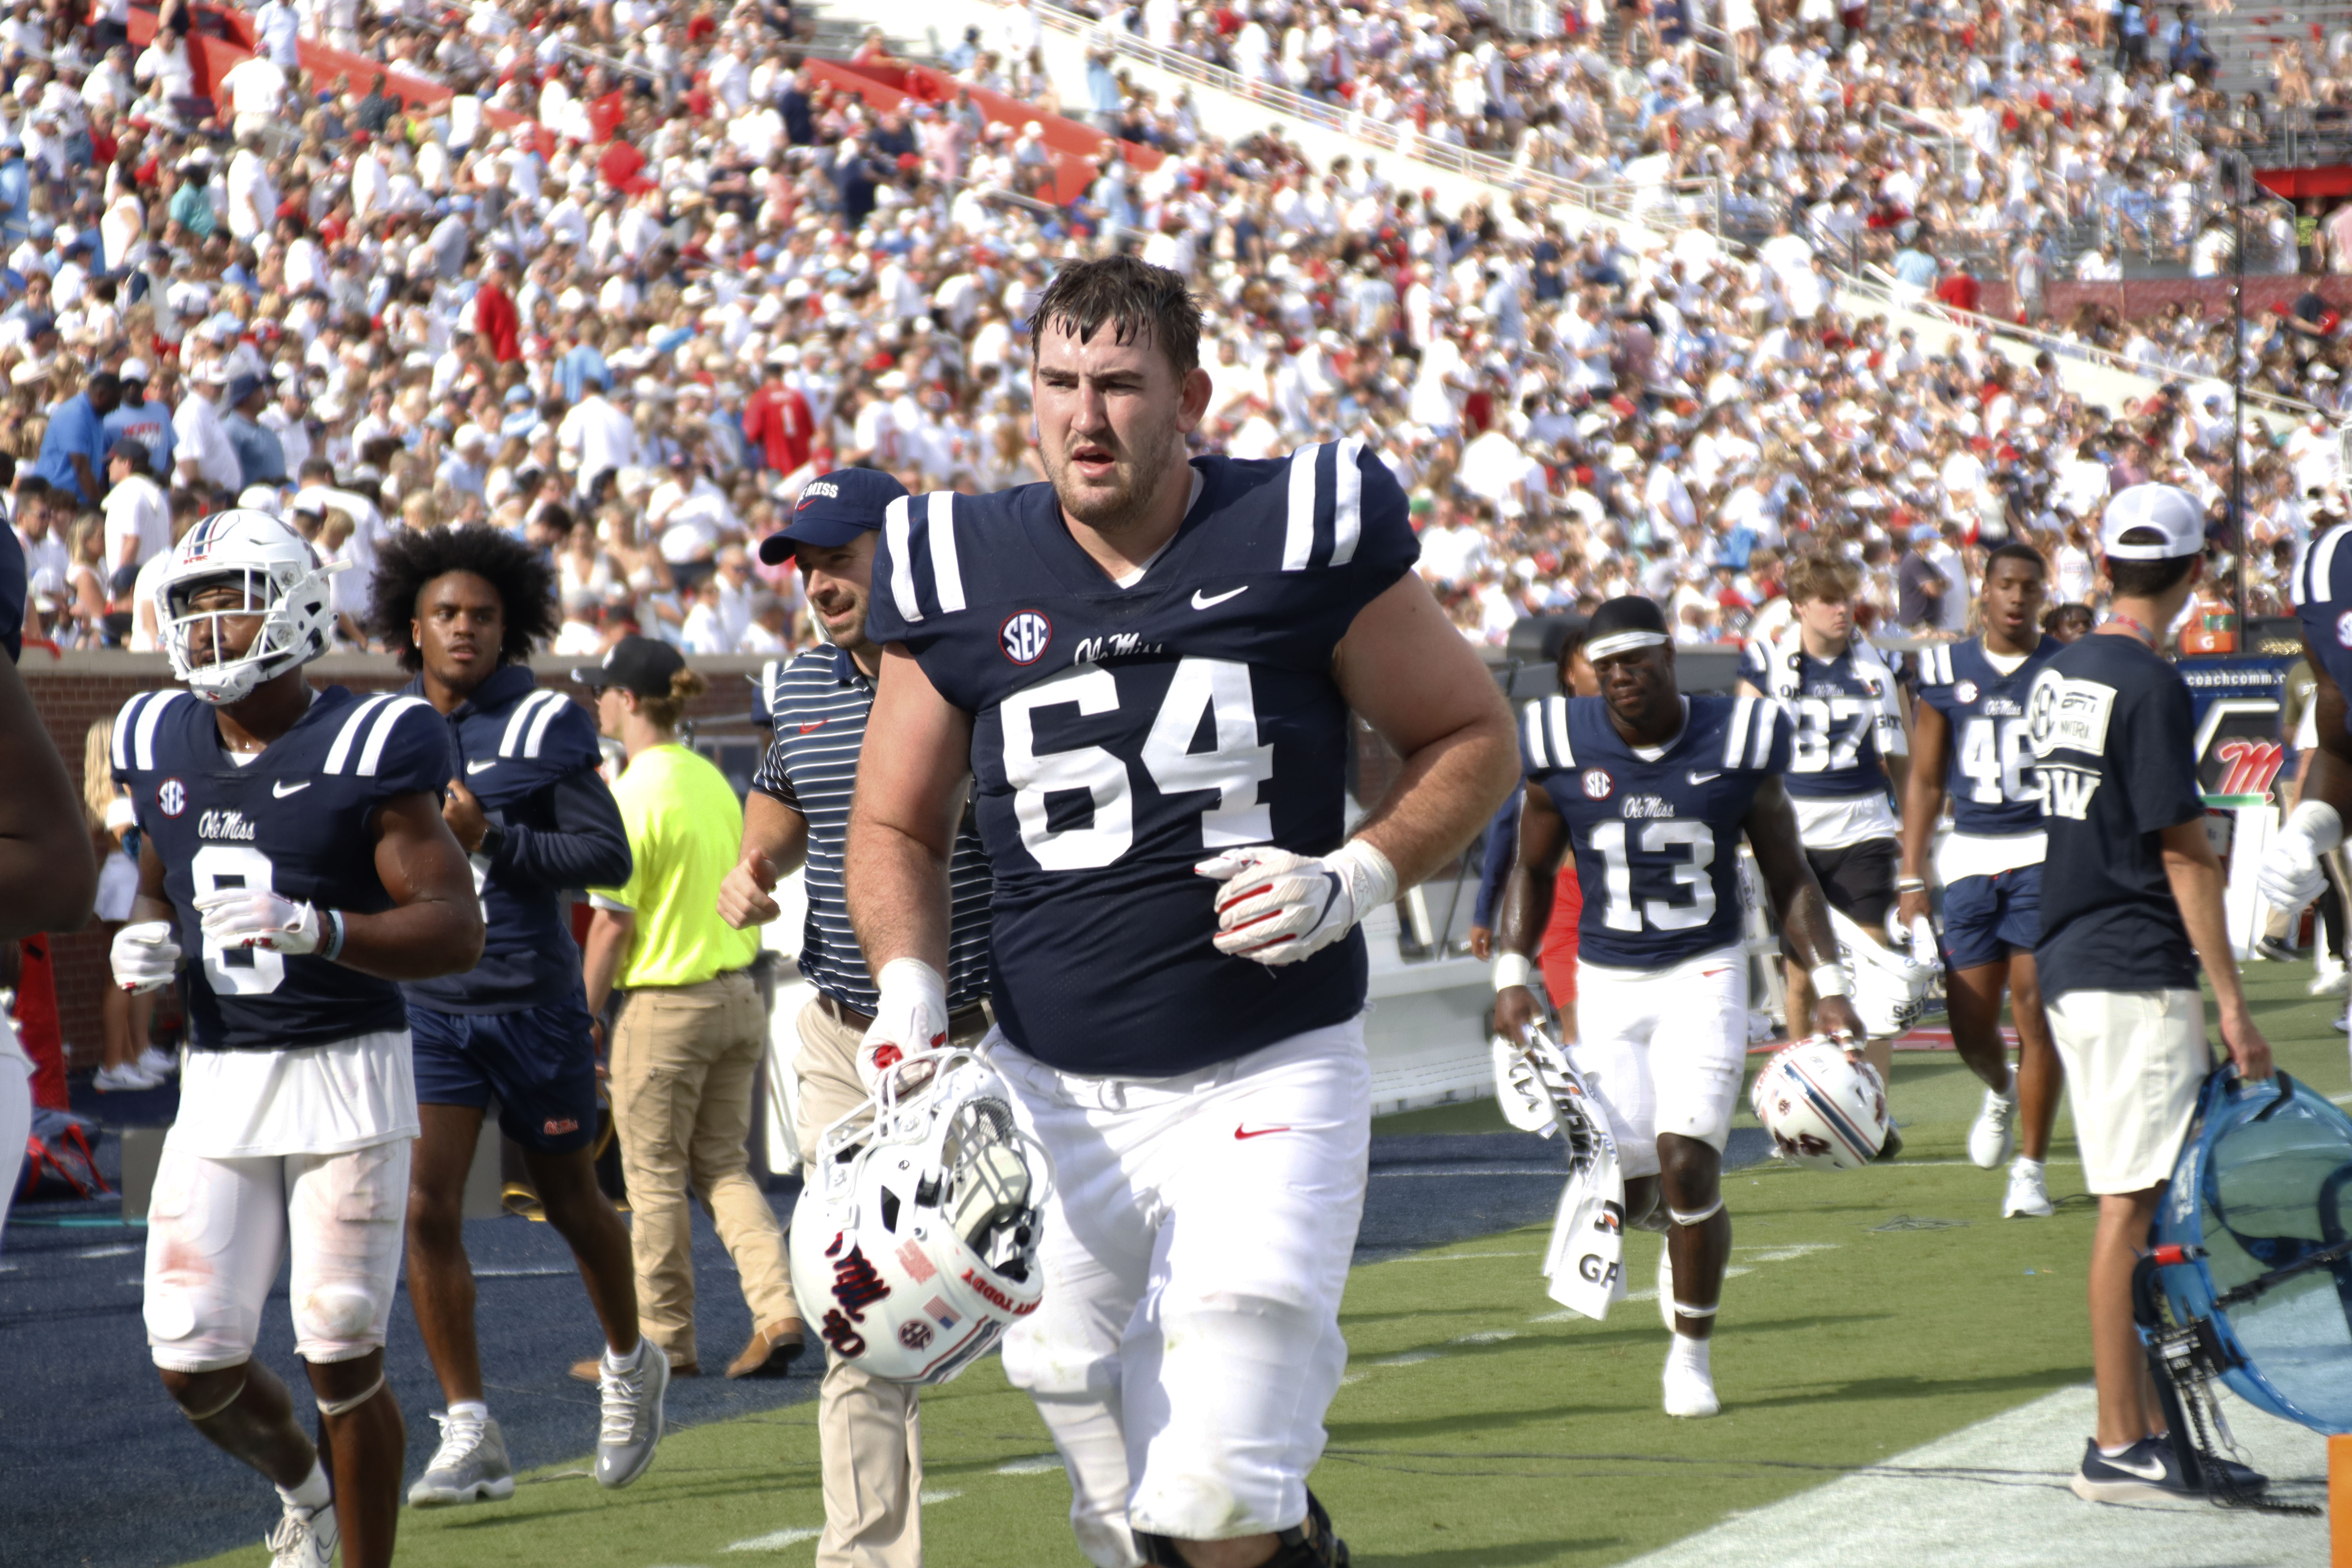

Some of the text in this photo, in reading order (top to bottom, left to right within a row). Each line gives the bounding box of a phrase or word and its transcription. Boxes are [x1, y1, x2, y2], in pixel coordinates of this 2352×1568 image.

[805, 482, 838, 498] MISS
[1003, 614, 1047, 662] SEC
[1985, 700, 2022, 716] Ole Miss
[1000, 655, 1274, 871] 64
[158, 779, 185, 816] SEC
[1586, 771, 1611, 798] SEC
[198, 810, 255, 840] Ole Miss
[1624, 797, 1675, 818] Ole Miss
[1593, 821, 1717, 932] 13
[961, 1267, 1014, 1311] TODDY
[822, 1308, 866, 1359] Ole
